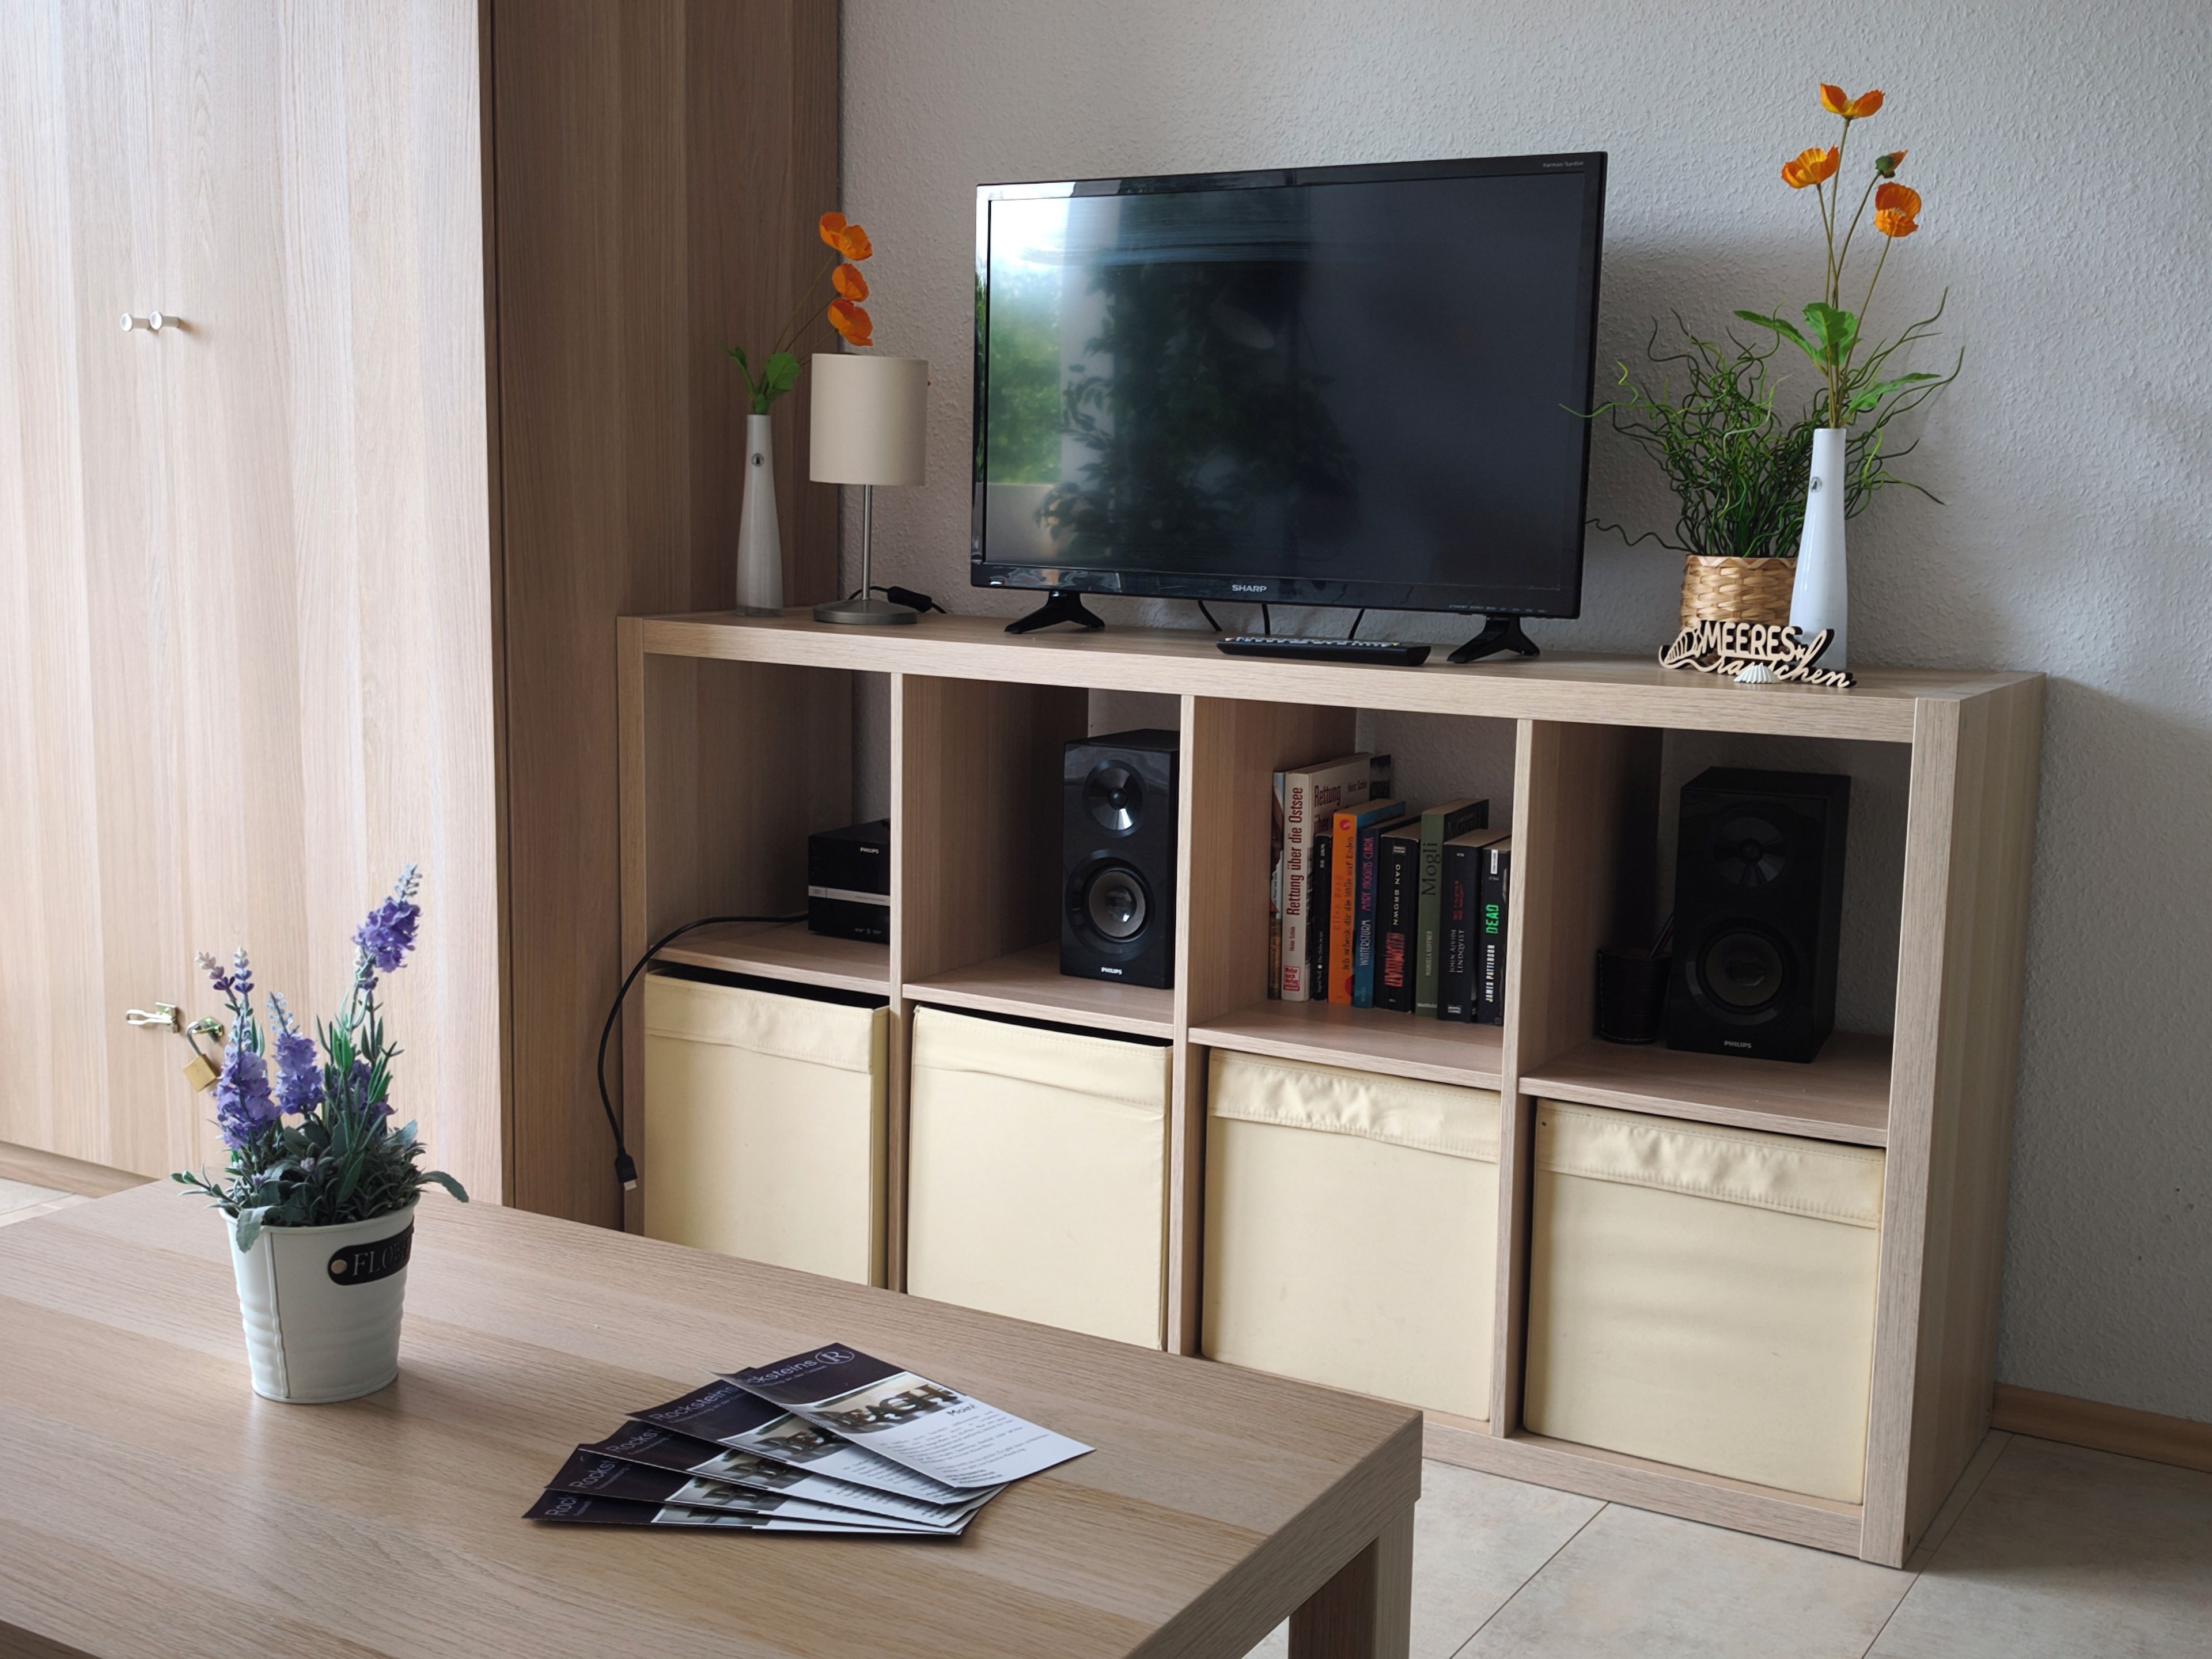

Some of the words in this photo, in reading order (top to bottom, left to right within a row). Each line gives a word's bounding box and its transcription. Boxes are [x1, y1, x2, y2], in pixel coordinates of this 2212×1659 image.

[1232, 584, 1267, 593] SHARP
[1700, 620, 1803, 662] MEERES
[1289, 787, 1303, 823] Ostsee
[1315, 785, 1341, 806] Rettung
[1288, 827, 1302, 843] die
[1287, 847, 1302, 870] über
[1346, 836, 1354, 859] Erden
[1421, 842, 1441, 896] Mogli
[1286, 874, 1304, 915] Rettung
[1334, 876, 1344, 897] Berg
[1332, 904, 1341, 930] Ellen
[1343, 914, 1351, 926] dir
[1486, 904, 1499, 934] DEAD
[1360, 919, 1371, 966] WINTERSTURM
[1448, 955, 1456, 974] JOHN
[1486, 945, 1495, 980] PATTERSON
[1485, 982, 1494, 1003] JAMES
[1724, 1040, 1752, 1048] PHILIPS
[649, 1385, 740, 1421] Rocksteins
